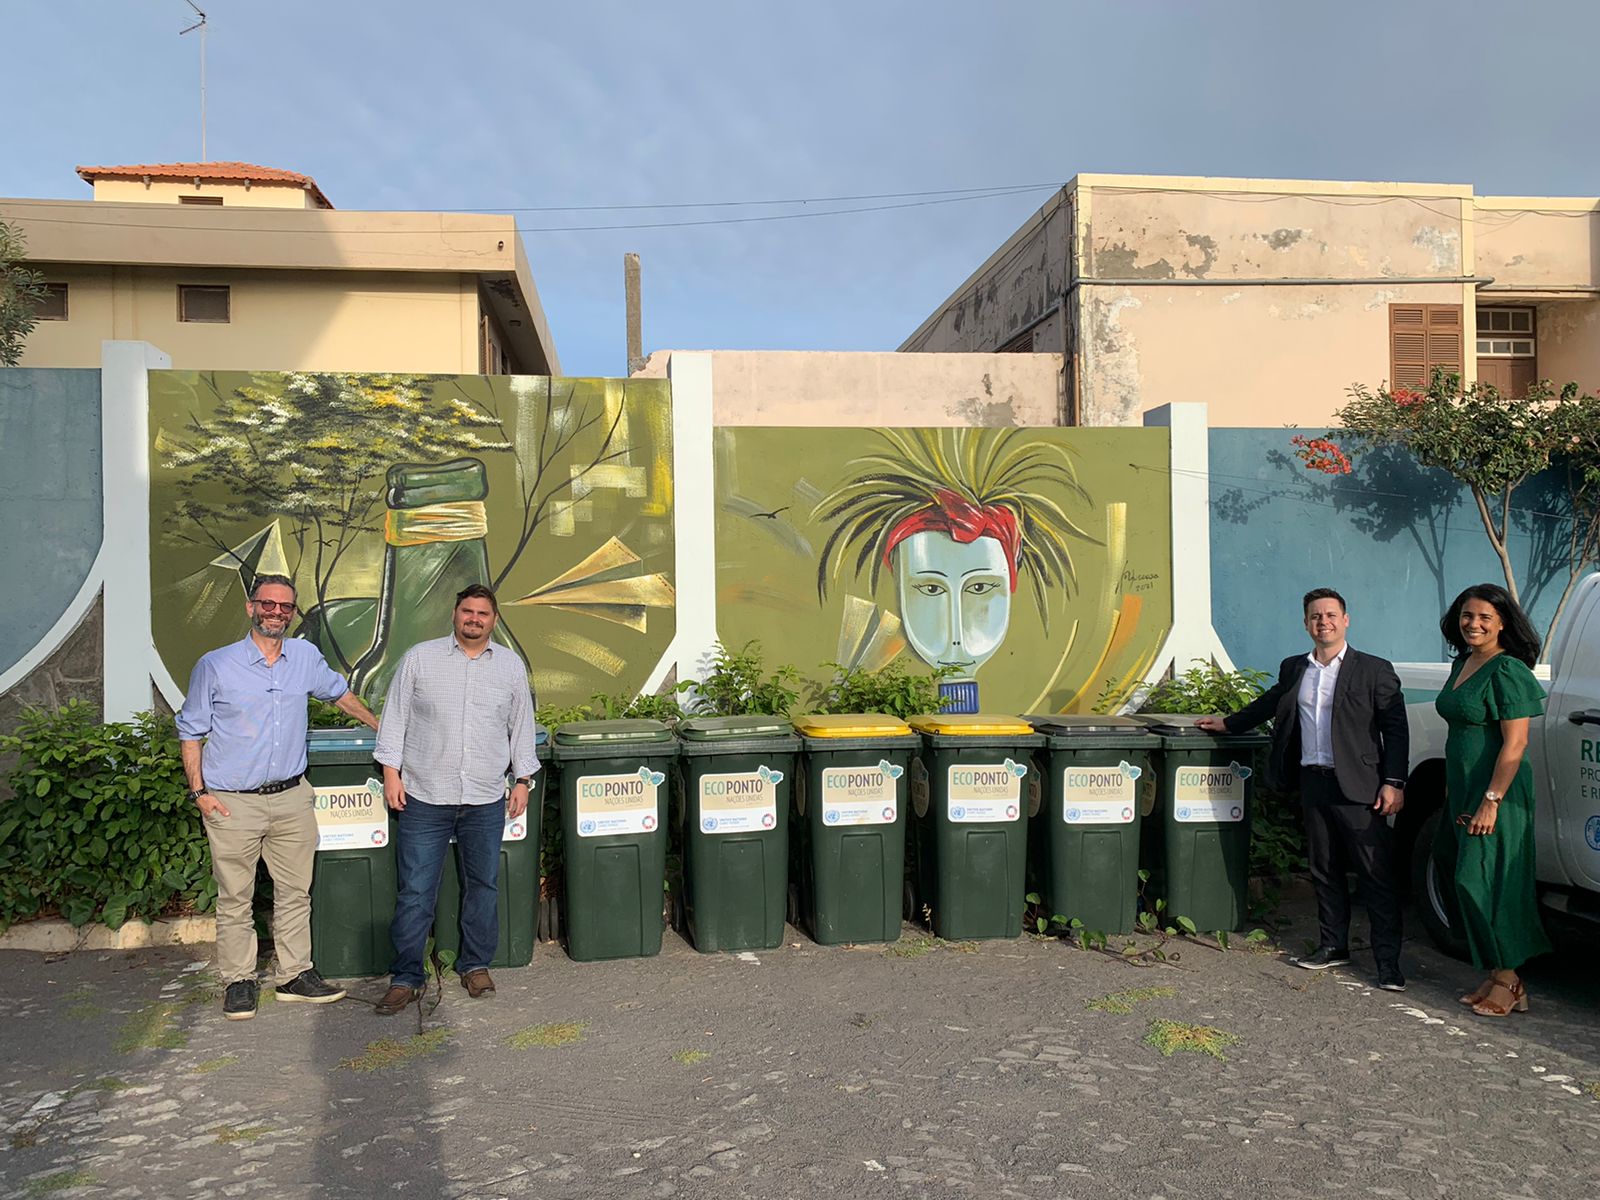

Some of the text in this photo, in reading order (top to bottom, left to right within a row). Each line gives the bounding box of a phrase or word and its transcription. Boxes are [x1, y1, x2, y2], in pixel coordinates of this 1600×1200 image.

[827, 773, 883, 788] ECOPONTO
[953, 772, 1008, 785] ECOPONTO
[1069, 773, 1123, 787] ECOPONTO
[1180, 773, 1232, 786] ECOPONTO
[582, 781, 643, 797] ECOPONTO
[704, 779, 763, 795] ECOPONTO
[1591, 787, 1600, 800] R
[313, 792, 372, 809] COPONTO
